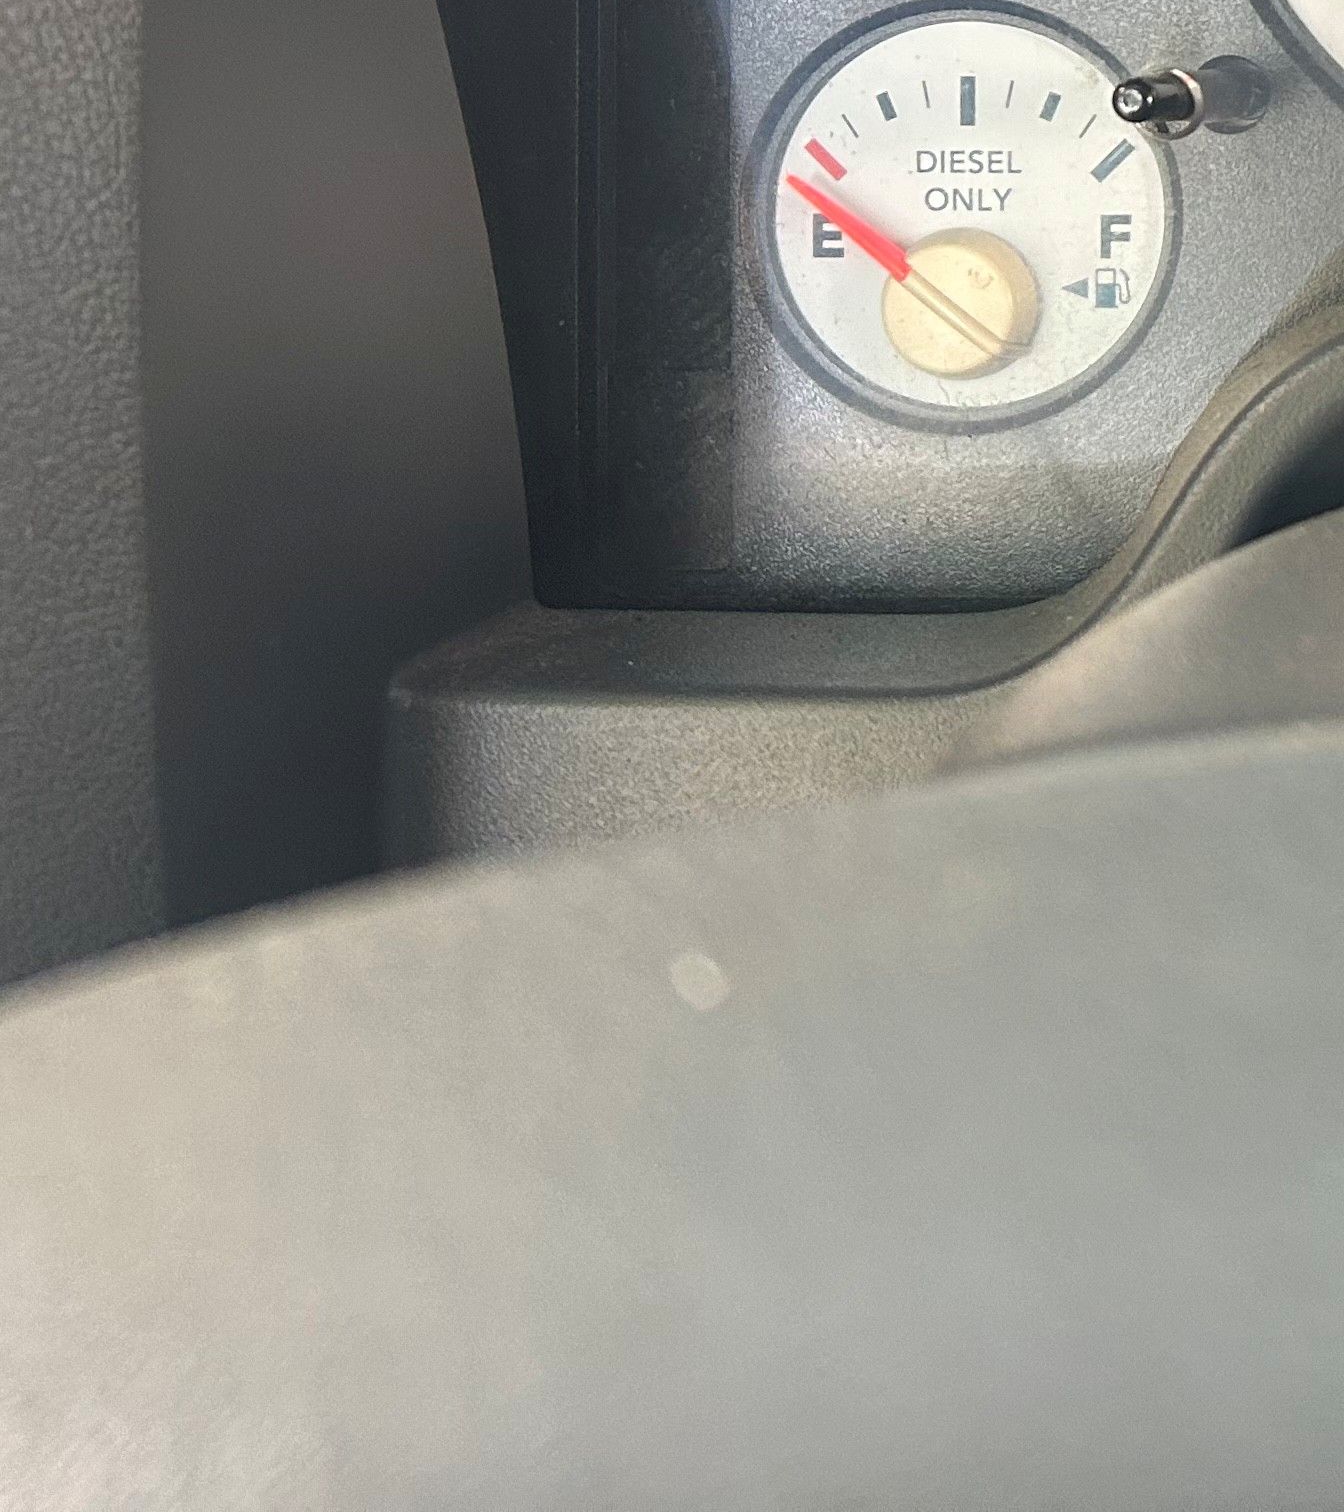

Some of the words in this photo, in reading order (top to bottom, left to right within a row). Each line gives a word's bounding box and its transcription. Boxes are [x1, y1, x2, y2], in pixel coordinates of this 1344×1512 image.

[917, 150, 1022, 174] DIESEL
[925, 187, 1012, 211] ONLY
[813, 214, 844, 258] E
[1100, 215, 1132, 259] F
